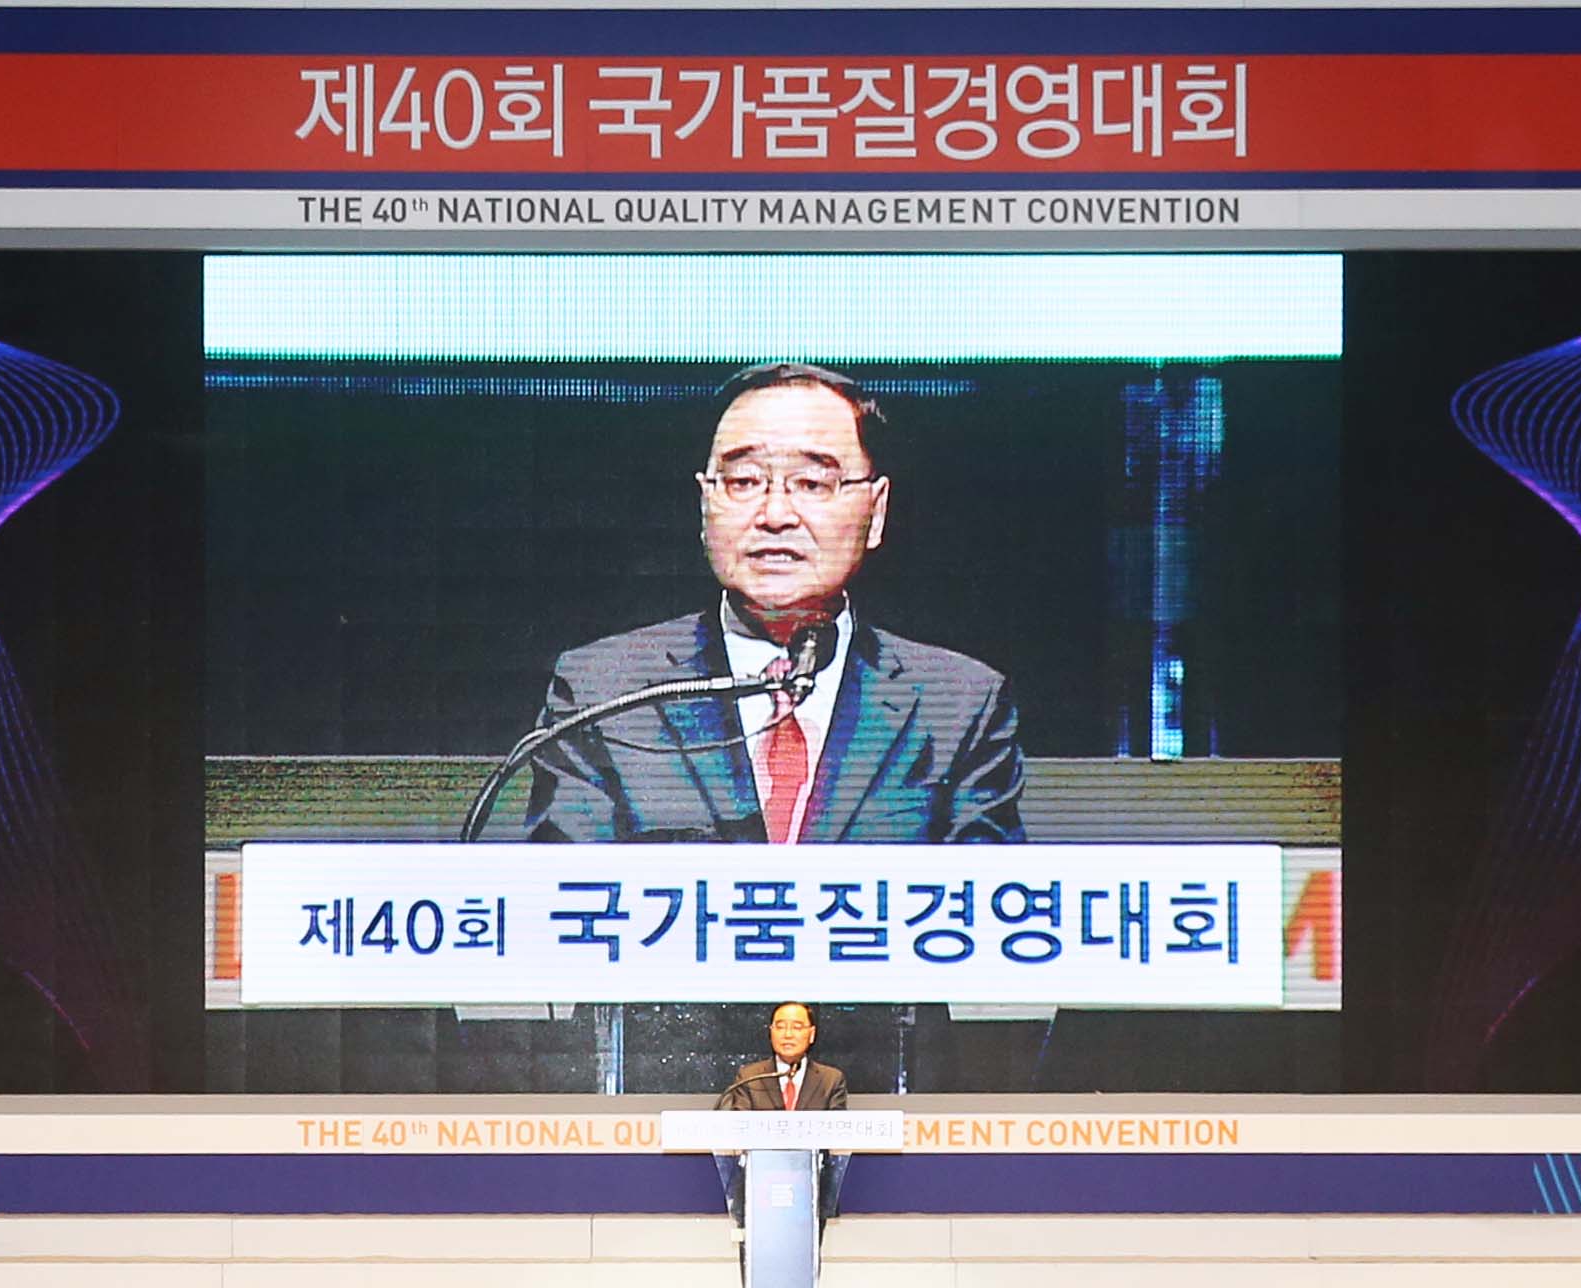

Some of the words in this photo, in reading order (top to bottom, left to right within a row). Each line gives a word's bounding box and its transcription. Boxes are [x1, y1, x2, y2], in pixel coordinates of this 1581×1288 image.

[295, 64, 563, 157] 제40회
[589, 64, 1246, 160] 국가품질경영대회
[297, 197, 363, 224] THE
[372, 197, 429, 224] 40th
[437, 197, 605, 224] NATIONAL
[614, 197, 749, 224] QUALITY
[758, 197, 1016, 225] MANAGEMENT
[1026, 197, 1241, 224] CONVENTION
[300, 898, 505, 956] 제40회
[550, 880, 1238, 963] 국가품질경영대회
[296, 1120, 363, 1149] THE
[436, 1120, 604, 1147] NATIONAL
[1026, 1119, 1238, 1147] CONVENTION
